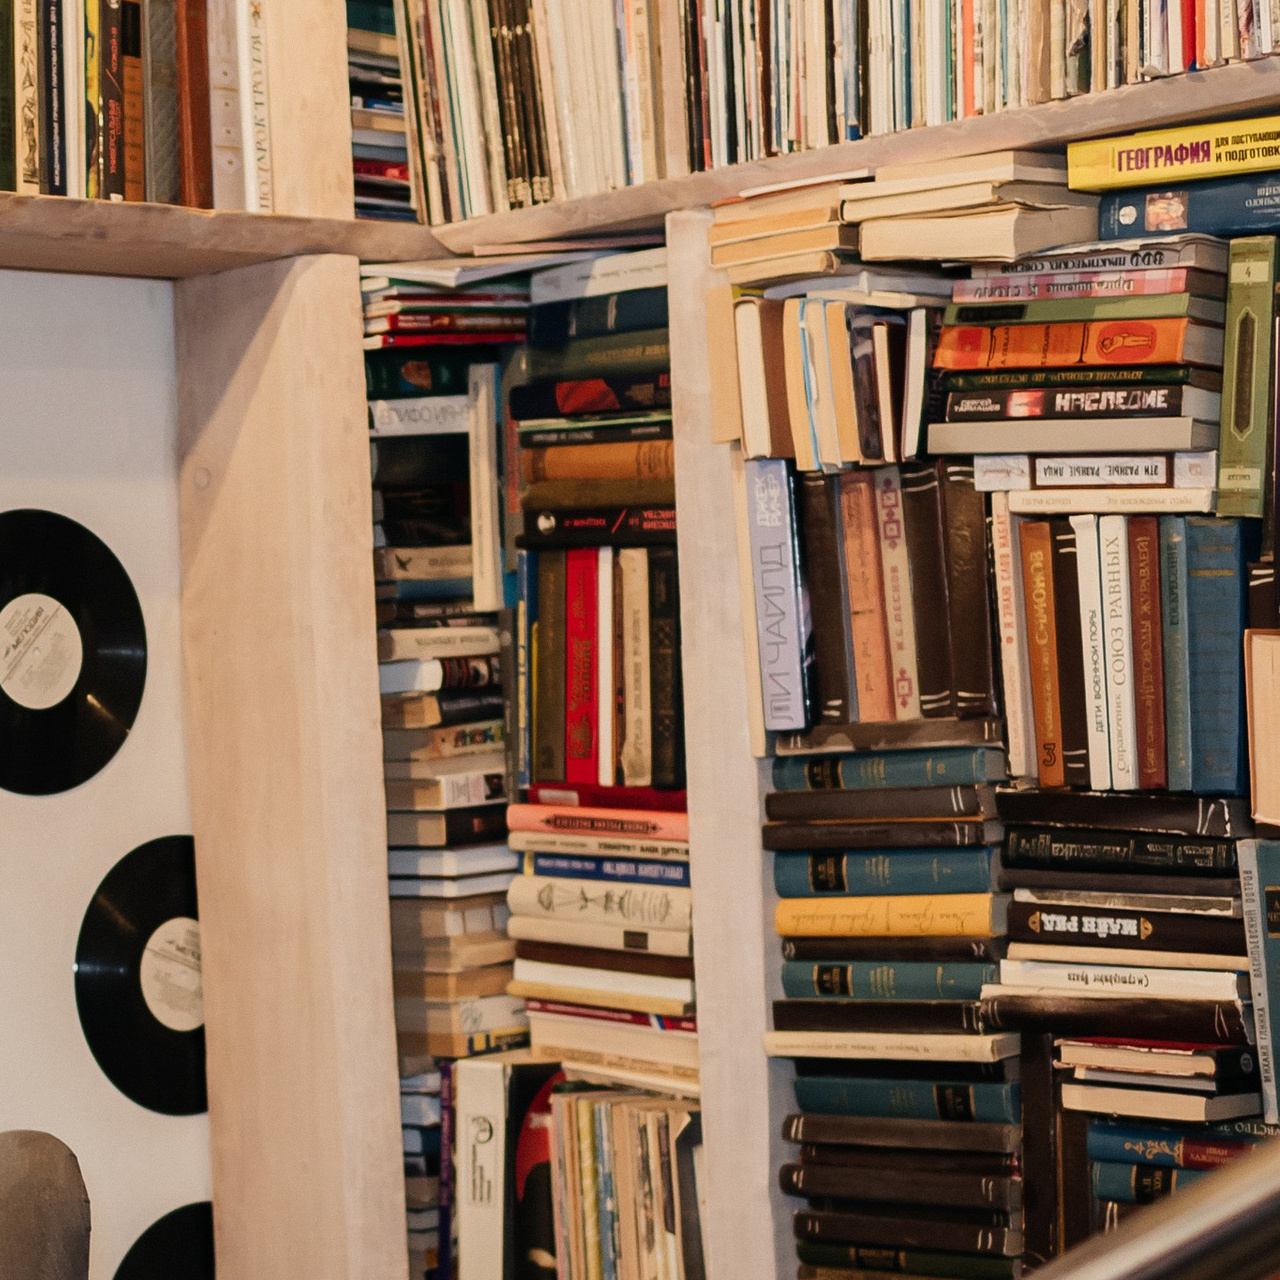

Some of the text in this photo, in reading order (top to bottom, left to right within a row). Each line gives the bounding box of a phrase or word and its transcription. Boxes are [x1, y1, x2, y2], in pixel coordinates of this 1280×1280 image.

[51, 68, 59, 121] ПРАВИЛА
[52, 122, 61, 187] МЕЖДУНАРОДНЫЕ
[109, 99, 118, 174] УНИВЕРСАЛЬНЫЙ
[1117, 140, 1211, 173] ГЕОГРАФИЯ
[1215, 136, 1229, 149] ДЛЯ
[254, 115, 270, 208] ПОДАРОК
[1000, 256, 1127, 275] ПРАКТИЧЕСКИХ СОВЕТОВ
[1045, 276, 1134, 295] Приглашение
[973, 284, 1021, 299] СТОЛУ
[1054, 388, 1168, 412] НАСЛЕДИЕ
[1042, 465, 1064, 482] ЛИЦА
[1067, 465, 1100, 481] РАЗНЫЕ
[1140, 465, 1159, 480] ЭТИ
[755, 477, 769, 526] ДЖЕК
[766, 474, 783, 526] РИЧЕР
[890, 565, 903, 622] ЛЕСКОВ
[1030, 550, 1048, 645] СИМОНОВ
[10, 605, 46, 653] МЕЛОДИЯ
[758, 542, 795, 723] ЛИ ЧАЙЛД
[1088, 609, 1104, 733] ДЕТИ ВОЕННОЙ ПОРЫ
[1104, 536, 1127, 772] Справочник СОЮЗ РАВНЫХ
[1043, 742, 1056, 767] 3
[1040, 912, 1138, 939] МАЙН РИД
[1242, 869, 1272, 1083] МИХАИЛ ГЛИНКА ВАСИЛЬЕВСКИЙ ОСТРОВ
